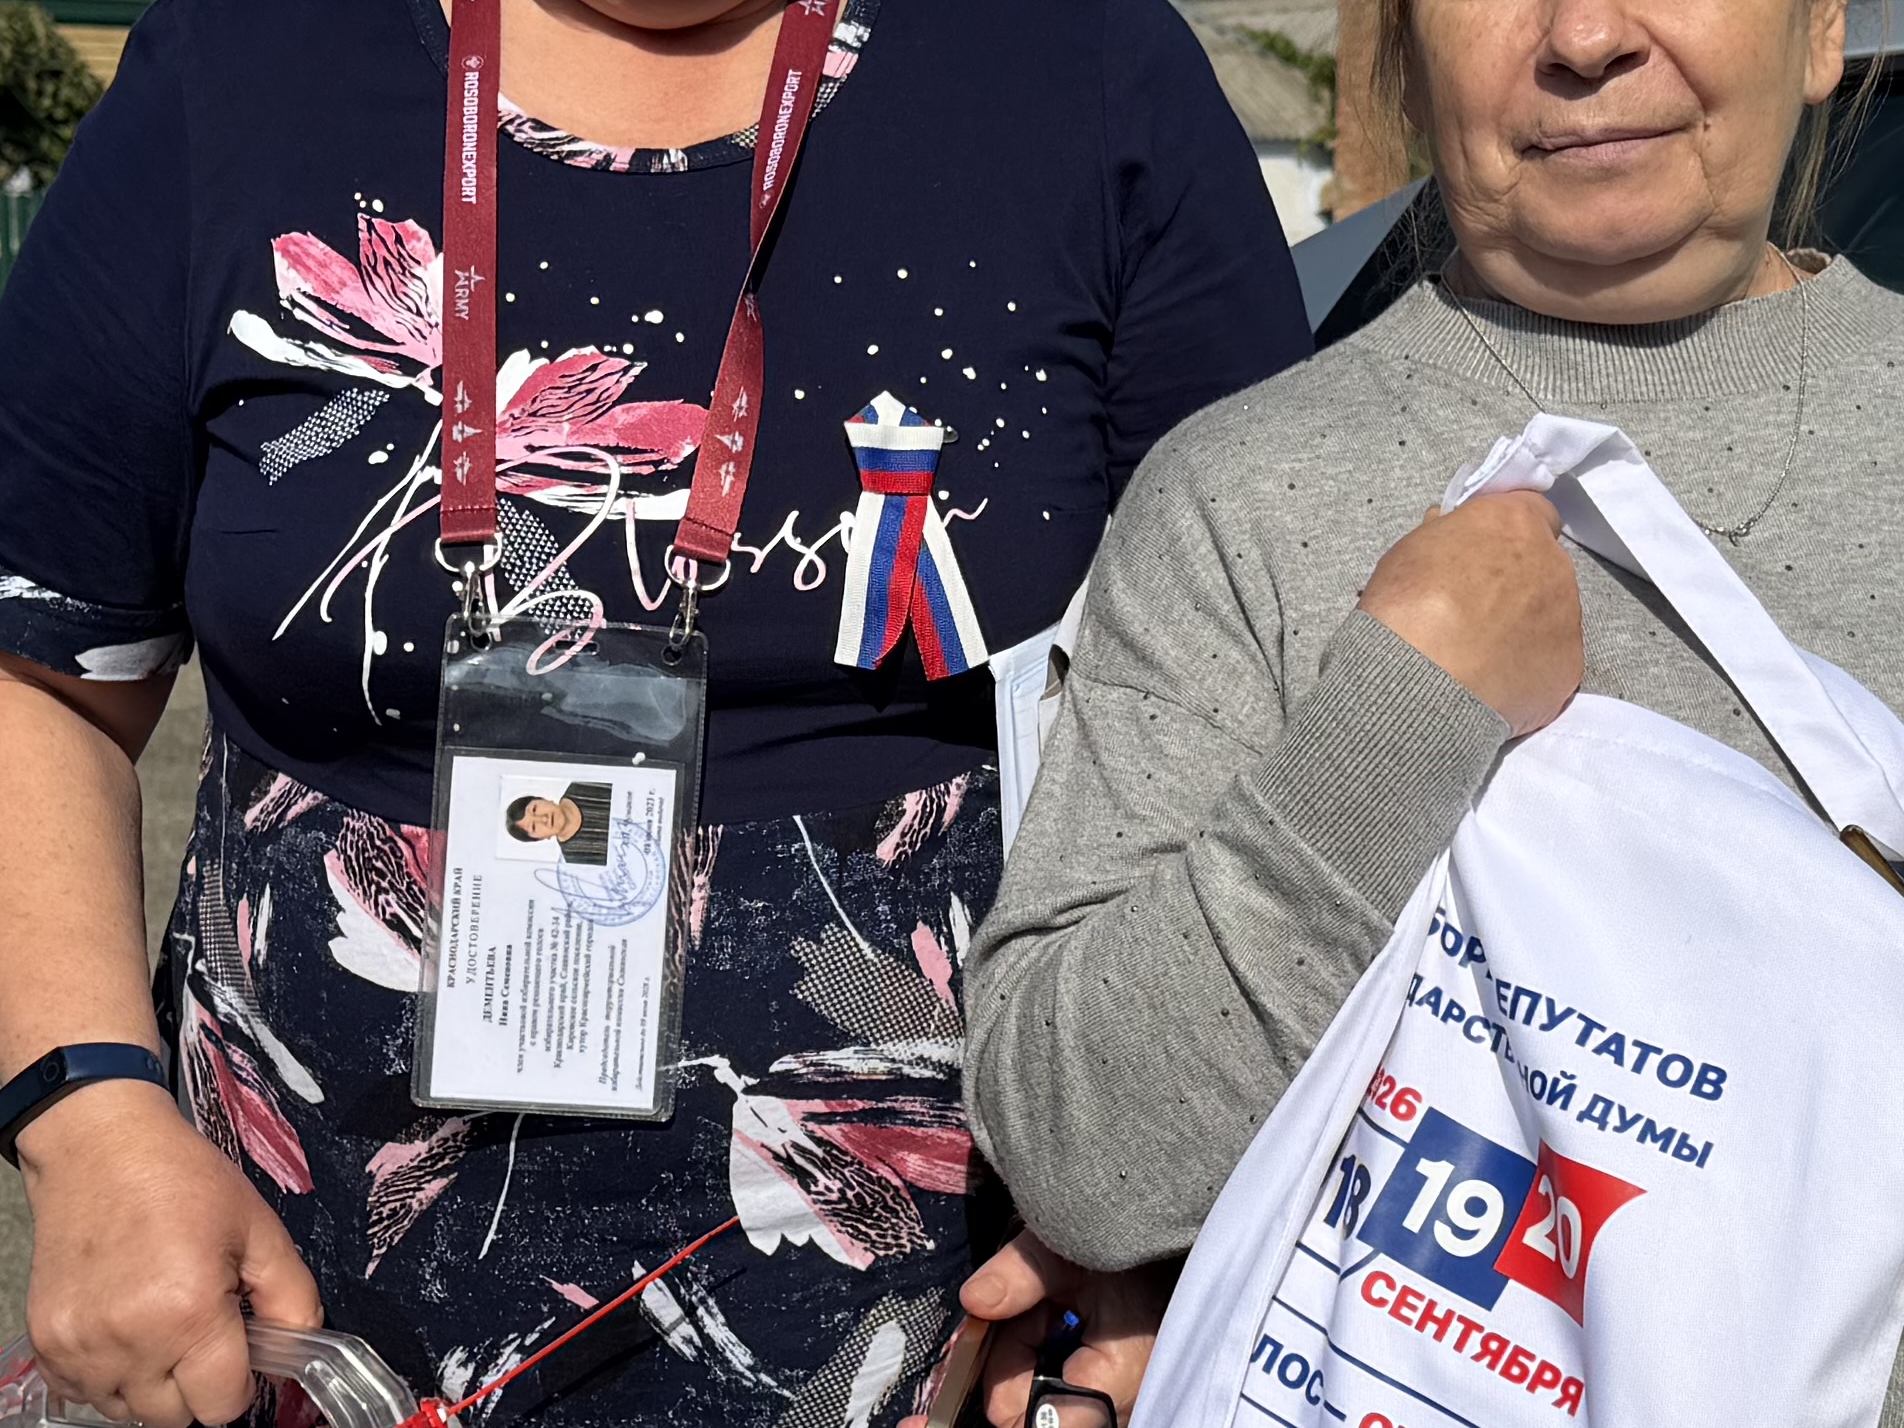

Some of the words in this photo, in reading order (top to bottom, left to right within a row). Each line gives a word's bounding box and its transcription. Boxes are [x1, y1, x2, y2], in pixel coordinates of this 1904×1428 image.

[462, 71, 479, 204] ROSOBORONEXPORT
[763, 68, 802, 191] ROSOBORONEXPORT
[465, 874, 482, 984] УДОСТОВЕРЕНИЕ
[1486, 968, 1728, 1101] ЕПУТАТОВ
[1576, 1093, 1714, 1170] ДУМЫ
[1323, 1154, 1372, 1241] 18
[1402, 1157, 1505, 1258] 19
[1521, 1174, 1583, 1279] 20
[1360, 1270, 1585, 1418] СЕНТЯБРЯ
